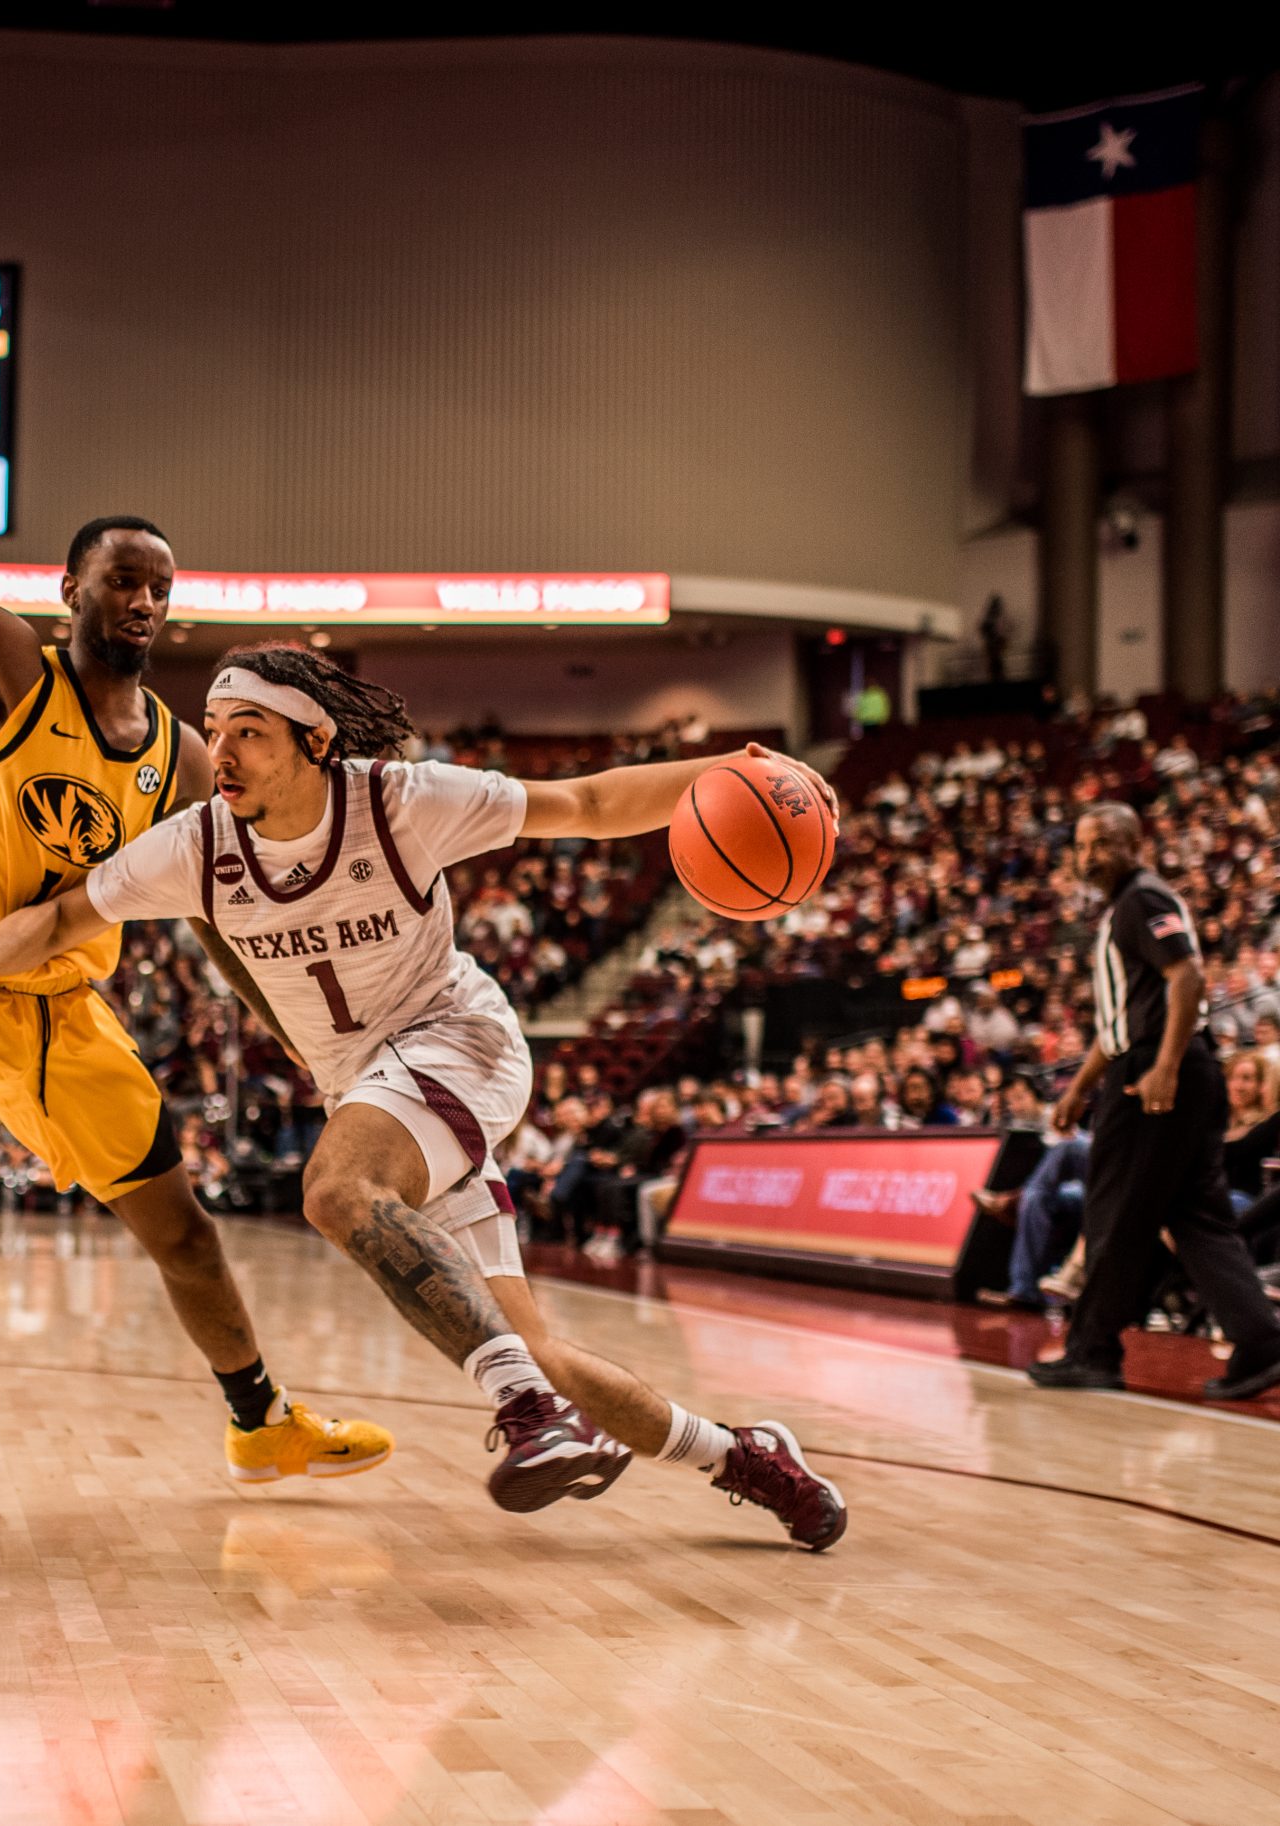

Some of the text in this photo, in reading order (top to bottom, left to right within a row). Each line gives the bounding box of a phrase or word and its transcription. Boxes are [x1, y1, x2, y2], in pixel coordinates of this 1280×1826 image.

[137, 769, 160, 793] SEC
[214, 864, 243, 875] UNIFIED
[351, 862, 372, 880] SEC
[229, 909, 400, 960] TEXAS A&M
[306, 959, 366, 1035] 1
